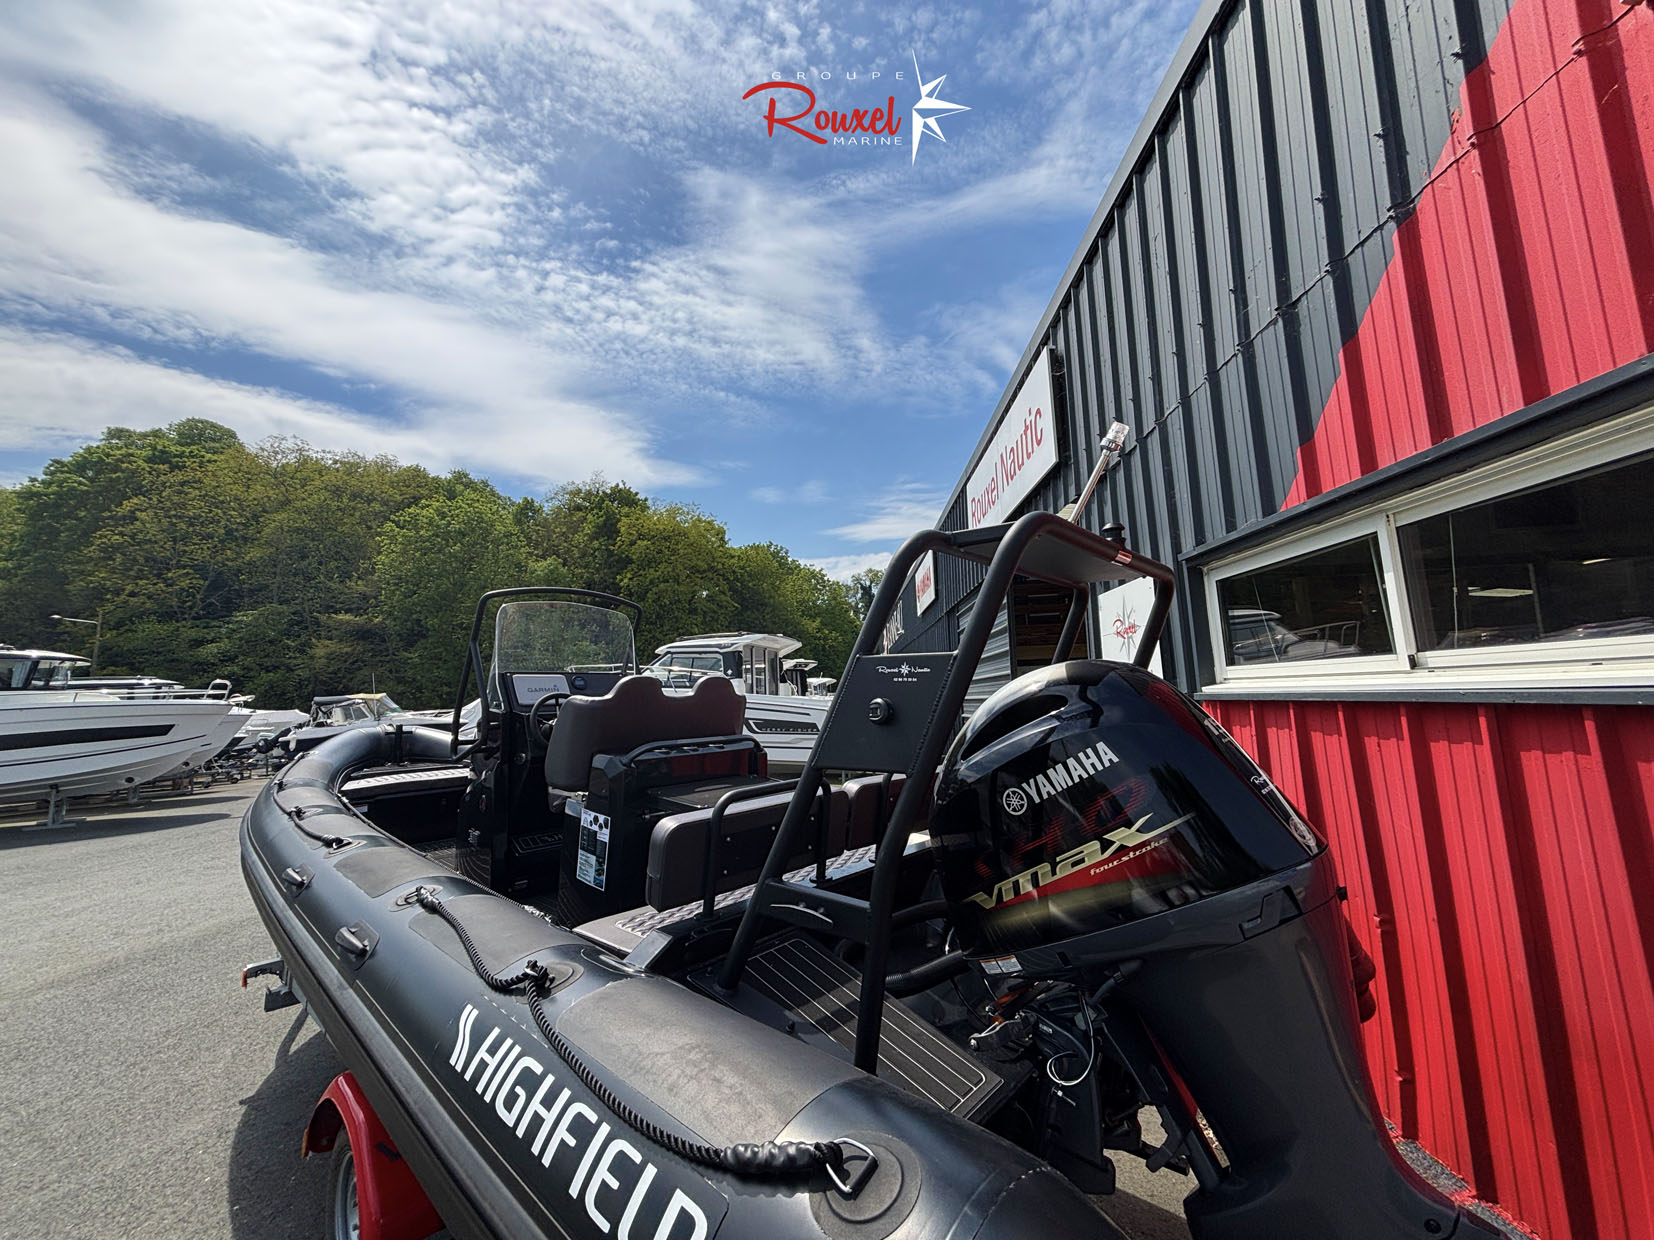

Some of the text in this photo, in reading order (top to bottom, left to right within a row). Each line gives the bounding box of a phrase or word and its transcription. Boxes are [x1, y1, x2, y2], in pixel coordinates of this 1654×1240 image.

[970, 407, 1044, 529] Rouxel Nautic
[1021, 741, 1120, 804] YAMAHA
